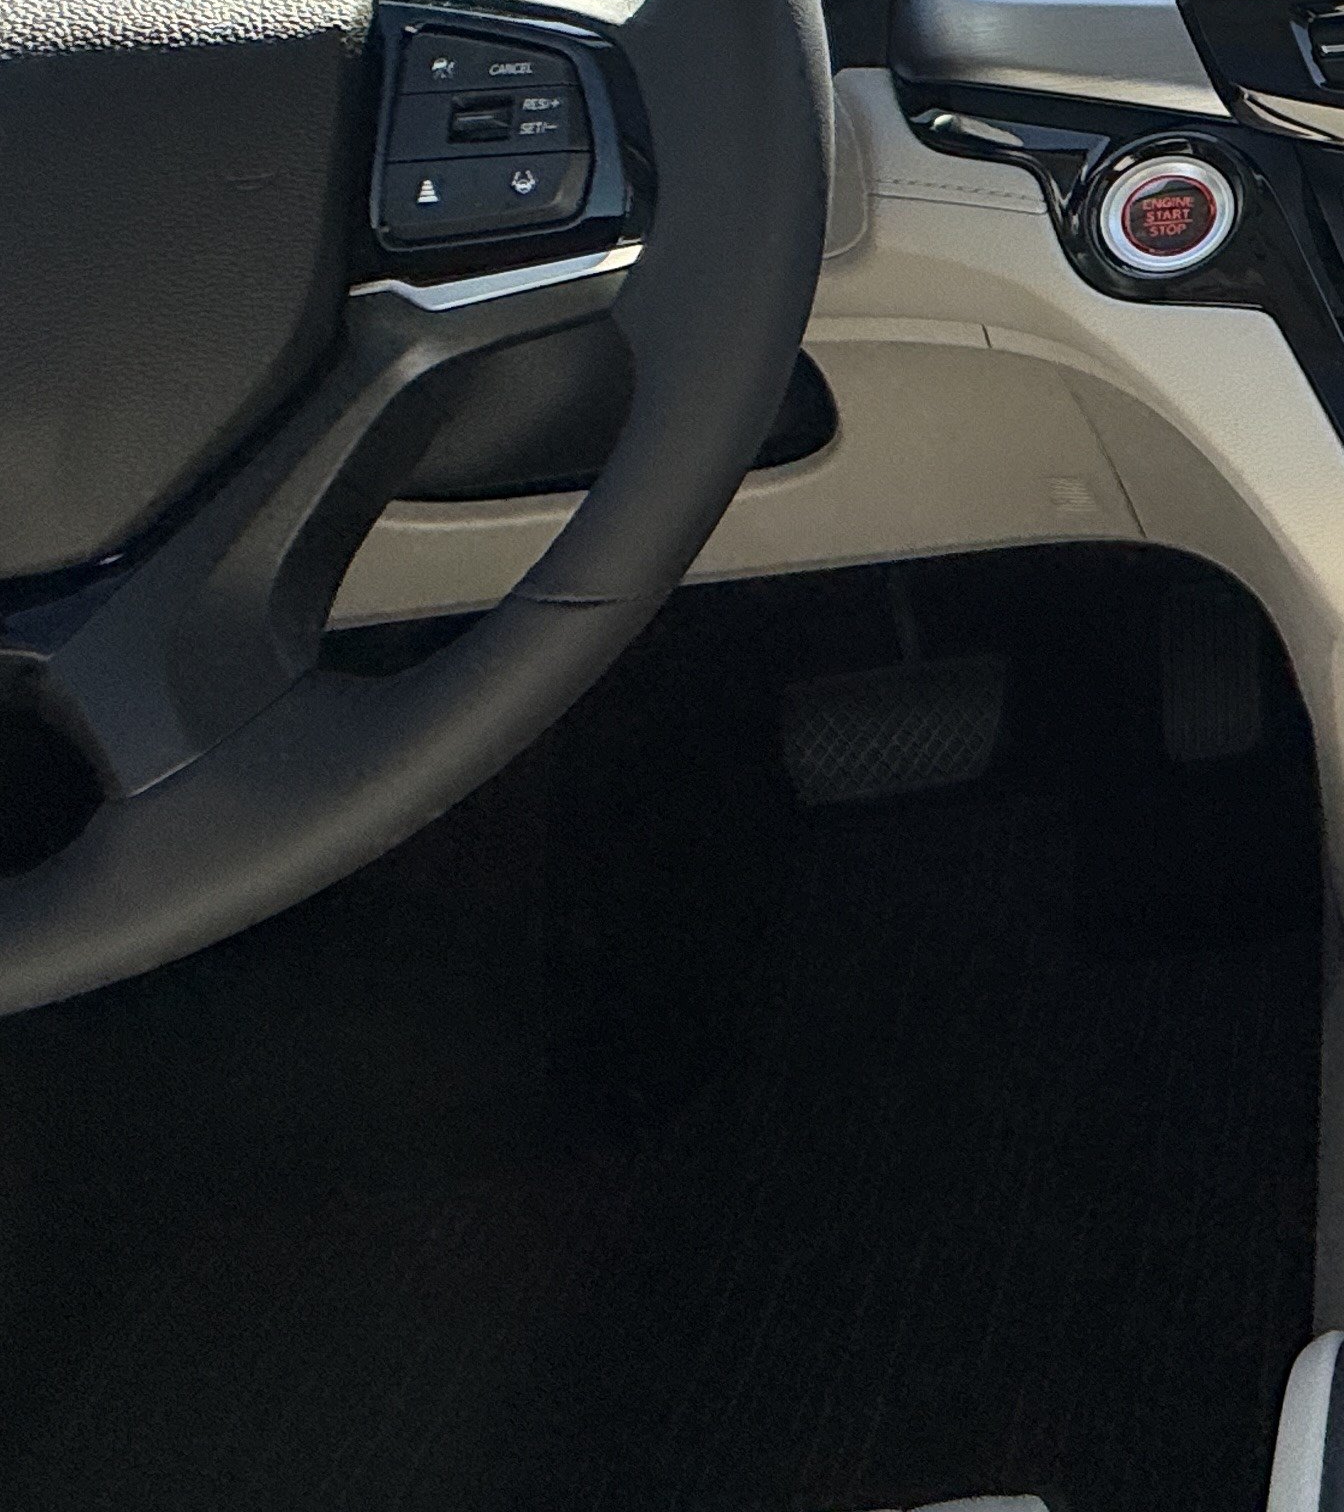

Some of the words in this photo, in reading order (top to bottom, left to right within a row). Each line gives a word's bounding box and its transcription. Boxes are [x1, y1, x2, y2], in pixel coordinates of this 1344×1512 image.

[489, 62, 533, 76] CANCEL
[1142, 196, 1194, 210] ENGINE
[1145, 208, 1190, 223] START
[1149, 222, 1187, 237] STOP
